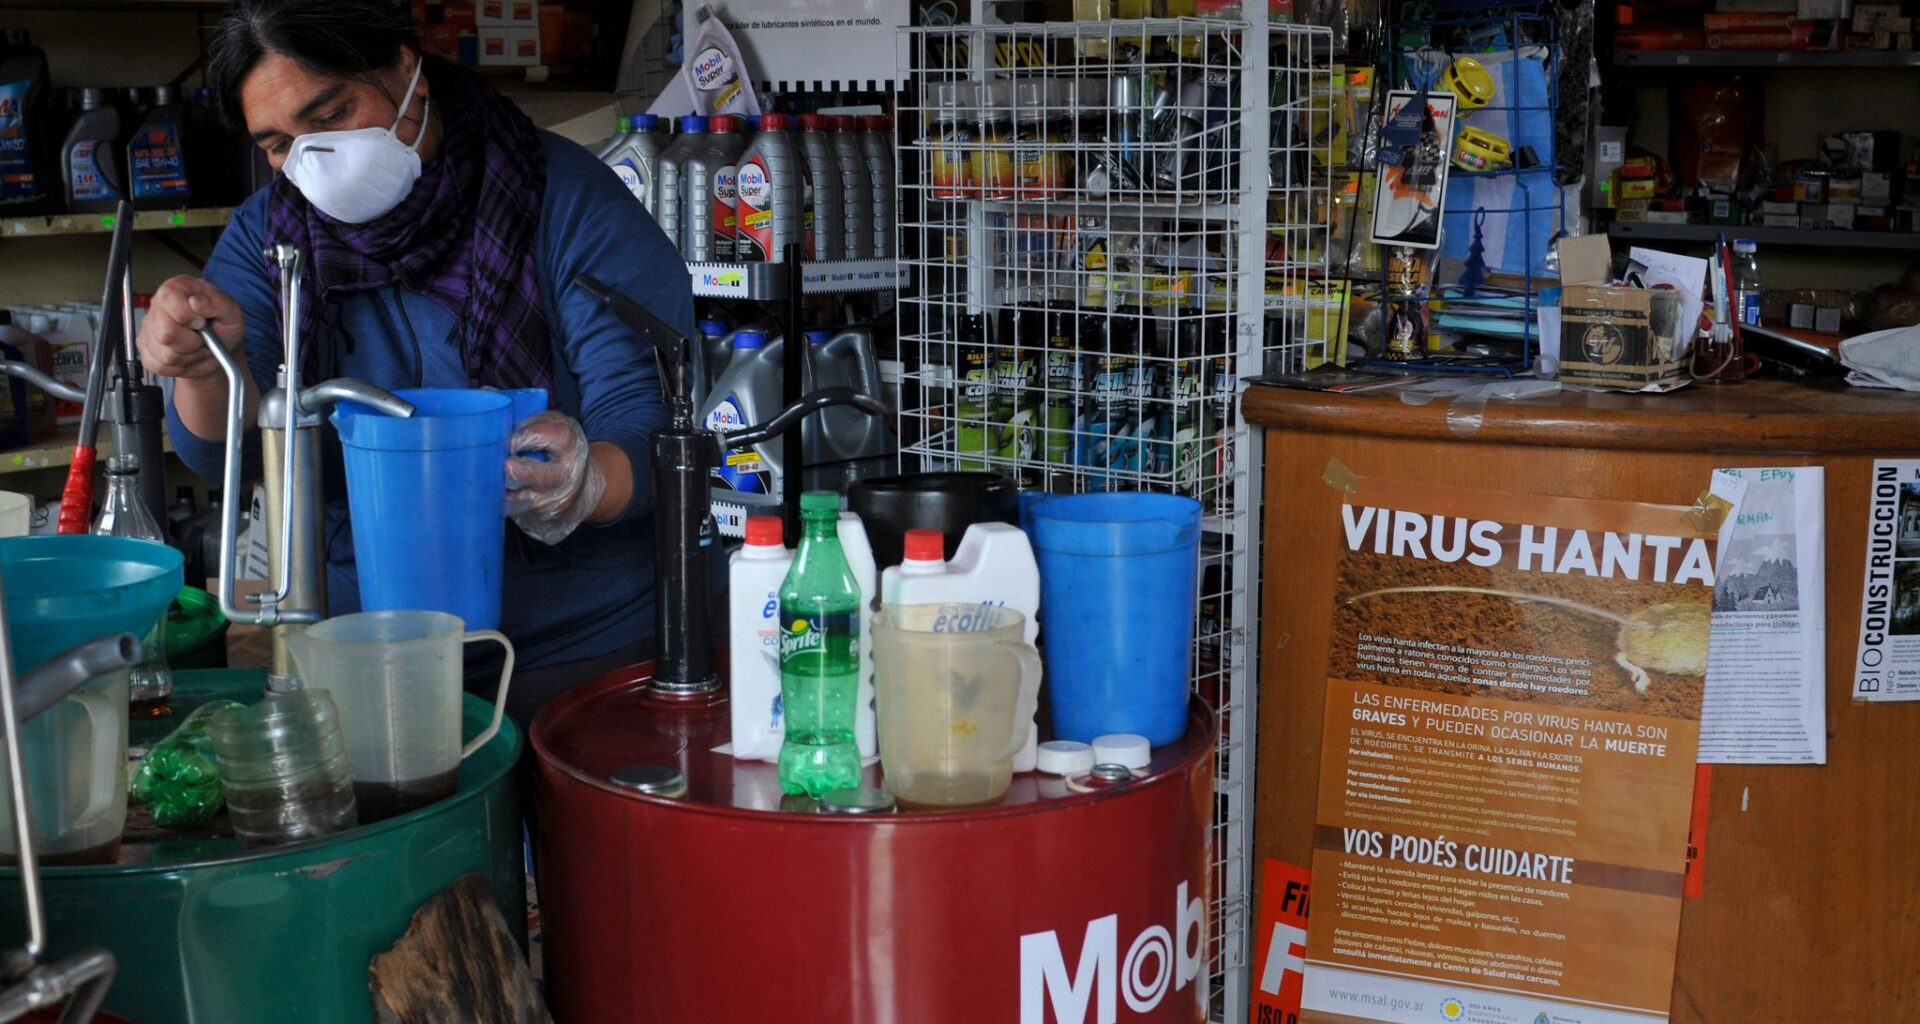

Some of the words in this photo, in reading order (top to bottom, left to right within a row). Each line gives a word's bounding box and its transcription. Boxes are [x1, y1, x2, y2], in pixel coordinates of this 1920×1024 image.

[751, 21, 760, 29] de
[761, 20, 799, 29] lubricantes
[800, 19, 834, 28] sintéticos
[847, 18, 853, 26] el
[855, 17, 881, 26] mundo.
[694, 54, 722, 77] Mobil
[698, 64, 724, 87] Super
[740, 172, 763, 185] Mobil
[740, 186, 762, 199] Super
[713, 411, 738, 425] Mobil
[1342, 503, 1503, 568] VIRUS
[1519, 523, 1716, 587] HANTA
[1859, 467, 1898, 693] BIOCONSTRUCCION
[780, 630, 819, 655] Sprite
[1358, 632, 1373, 642] Los
[1373, 635, 1393, 644] virus
[1393, 637, 1417, 647] hanta
[1417, 640, 1450, 651] infectan
[1450, 645, 1457, 653] a
[1457, 645, 1465, 654] la
[1465, 647, 1499, 659] mayoría
[1499, 649, 1512, 659] de
[1511, 650, 1525, 660] los
[1564, 657, 1592, 668] princi-
[1356, 651, 1395, 664] humanos
[1398, 657, 1425, 667] tienen
[1428, 661, 1455, 673] riesgo
[1457, 664, 1470, 674] de
[1472, 668, 1508, 678] contraer
[1511, 671, 1571, 684] enfermedades
[1575, 678, 1591, 687] por
[1357, 643, 1396, 654] palmente
[1403, 649, 1435, 659] ratones
[1436, 653, 1480, 665] conocidos
[1480, 659, 1506, 668] como
[1552, 665, 1568, 675] Los
[1569, 668, 1592, 676] seres
[1356, 661, 1376, 671] virus
[1376, 663, 1400, 674] hanta
[1413, 669, 1436, 679] todas
[1437, 673, 1471, 683] aquellas
[1472, 677, 1498, 687] zonas
[1499, 679, 1529, 689] donde
[1529, 682, 1547, 693] hay
[1885, 670, 1896, 694] INFO
[1352, 708, 1406, 726] GRAVES
[1411, 715, 1420, 728] Y
[1426, 718, 1484, 736] PUEDEN
[1491, 726, 1573, 745] OCASIONAR
[1580, 735, 1599, 749] LA
[1605, 739, 1665, 756] MUERTE
[1353, 692, 1380, 707] LAS
[1384, 696, 1498, 721] ENFERMEDADES
[1503, 710, 1533, 725] POR
[1537, 714, 1579, 730] VIRUS
[1584, 719, 1632, 735] HANTA
[1636, 724, 1668, 740] SON
[1343, 827, 1384, 858] VOS
[1389, 834, 1458, 869] PODÉS
[1464, 844, 1575, 885] CUIDARTE
[1343, 860, 1376, 872] Mantené
[1376, 865, 1384, 873] la
[1384, 867, 1416, 878] vivienda
[1416, 870, 1440, 881] limpia
[1439, 875, 1457, 884] para
[1457, 878, 1479, 886] evitar
[1479, 879, 1488, 888] la
[1487, 882, 1524, 893] presencia
[1523, 886, 1535, 895] de
[1340, 910, 1389, 924] directamente
[1389, 918, 1410, 927] sobre
[1410, 920, 1418, 928] el
[1332, 947, 1366, 958] consultá
[1367, 952, 1432, 967] inmediatamente
[1432, 961, 1441, 969] al
[1442, 962, 1470, 973] Centro
[1470, 966, 1482, 975] de
[1482, 967, 1507, 978] Salud
[1506, 972, 1525, 981] más
[1329, 987, 1425, 1013] www.msal.gov.ar
